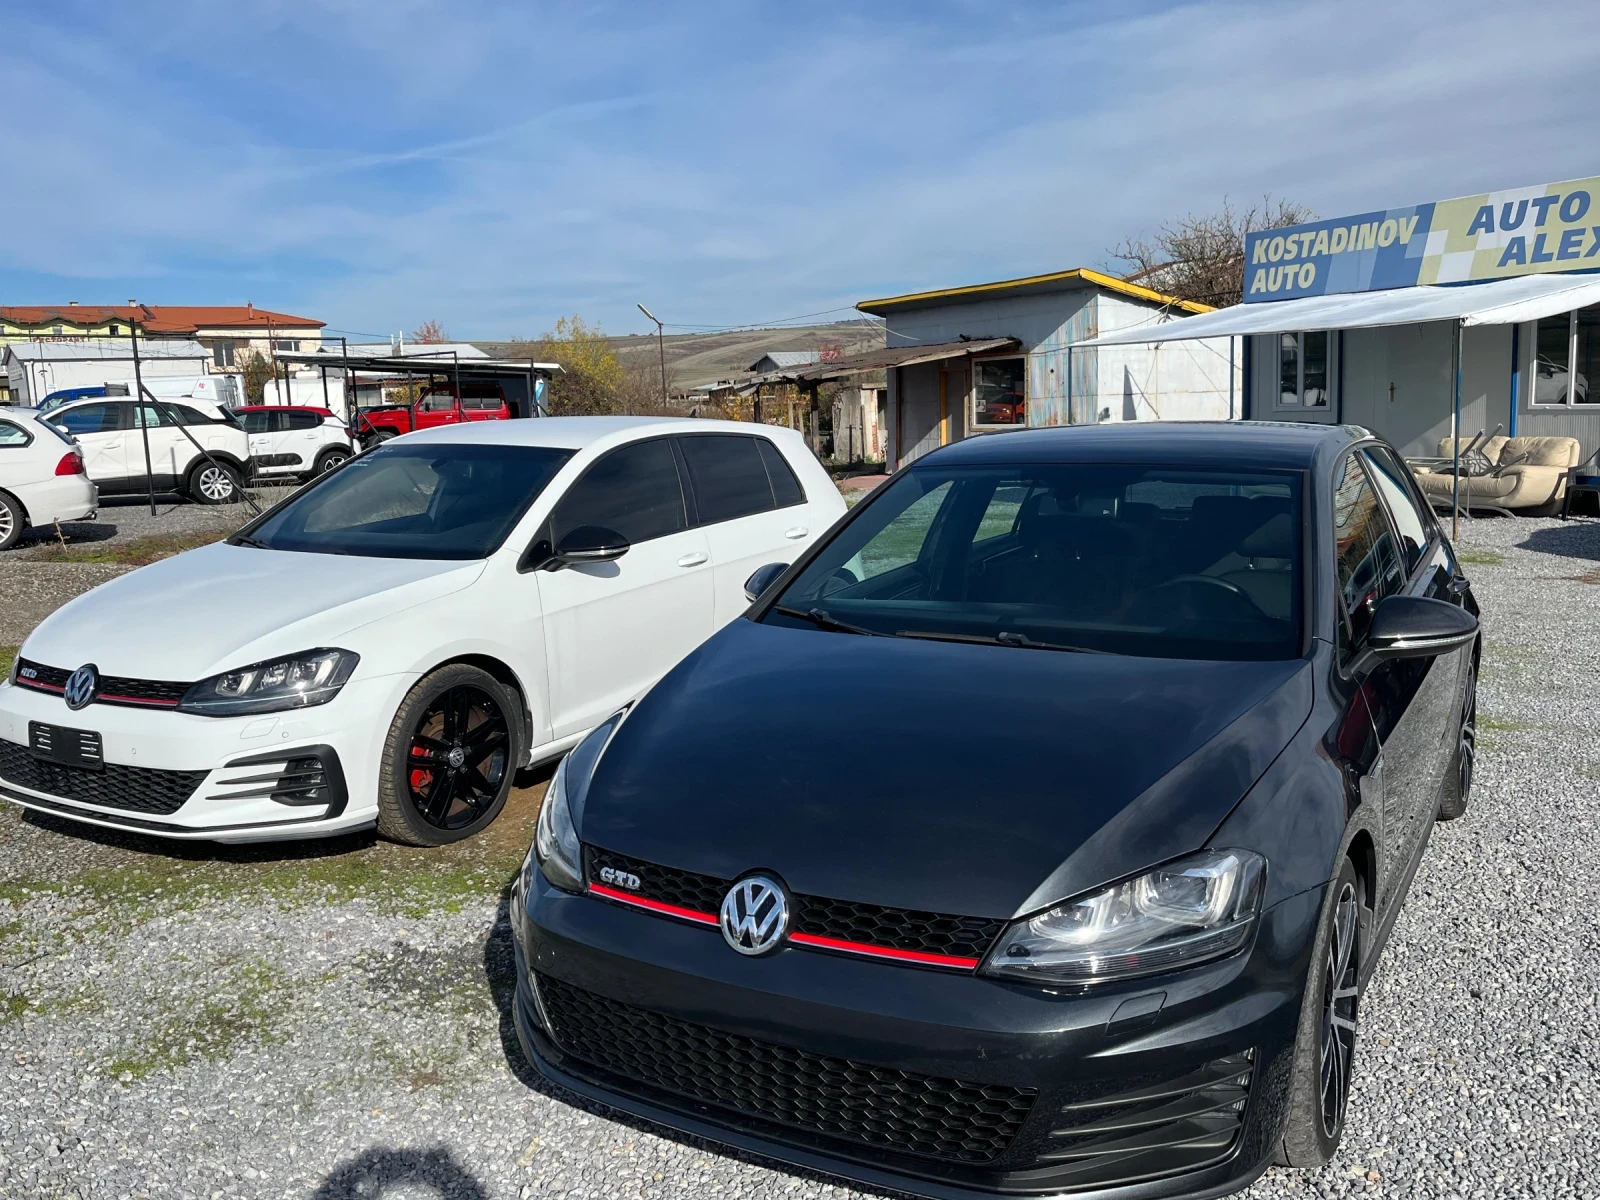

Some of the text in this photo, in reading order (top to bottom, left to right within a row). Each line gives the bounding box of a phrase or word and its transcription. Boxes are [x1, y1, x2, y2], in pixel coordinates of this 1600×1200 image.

[1467, 190, 1591, 236] AUTO
[1252, 215, 1419, 265] KOSTADINOV
[1250, 262, 1316, 294] AUTO
[600, 866, 641, 890] GTD
[720, 876, 789, 955] VW
